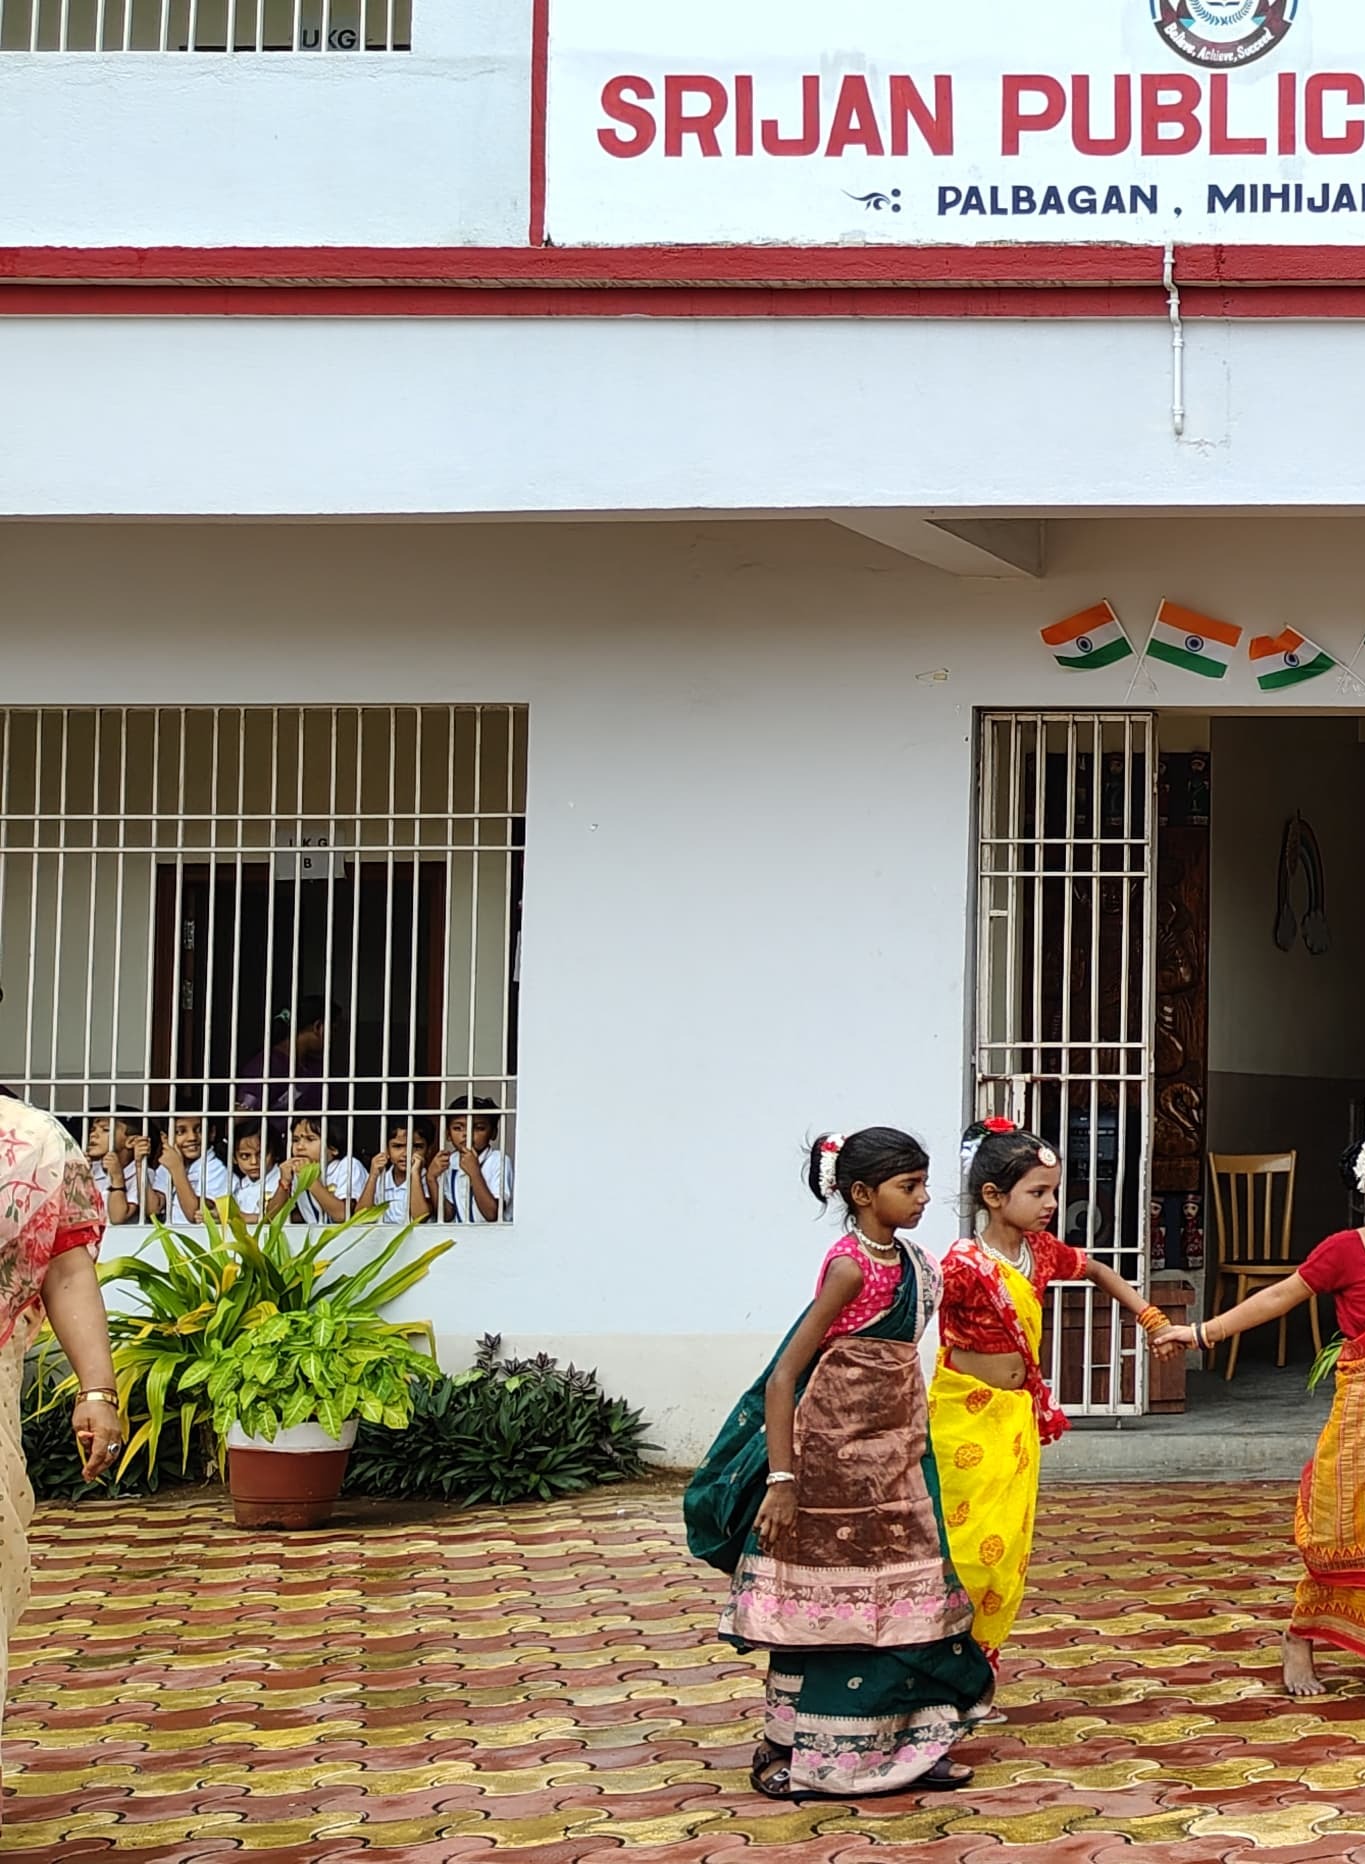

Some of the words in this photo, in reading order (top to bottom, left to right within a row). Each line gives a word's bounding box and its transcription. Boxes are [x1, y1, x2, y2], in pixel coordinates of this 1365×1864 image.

[302, 29, 357, 49] UKG
[597, 74, 954, 159] SRIJAN
[1000, 73, 1365, 157] PUBLIC
[937, 185, 1159, 216] PALBAGAN
[303, 858, 312, 869] B
